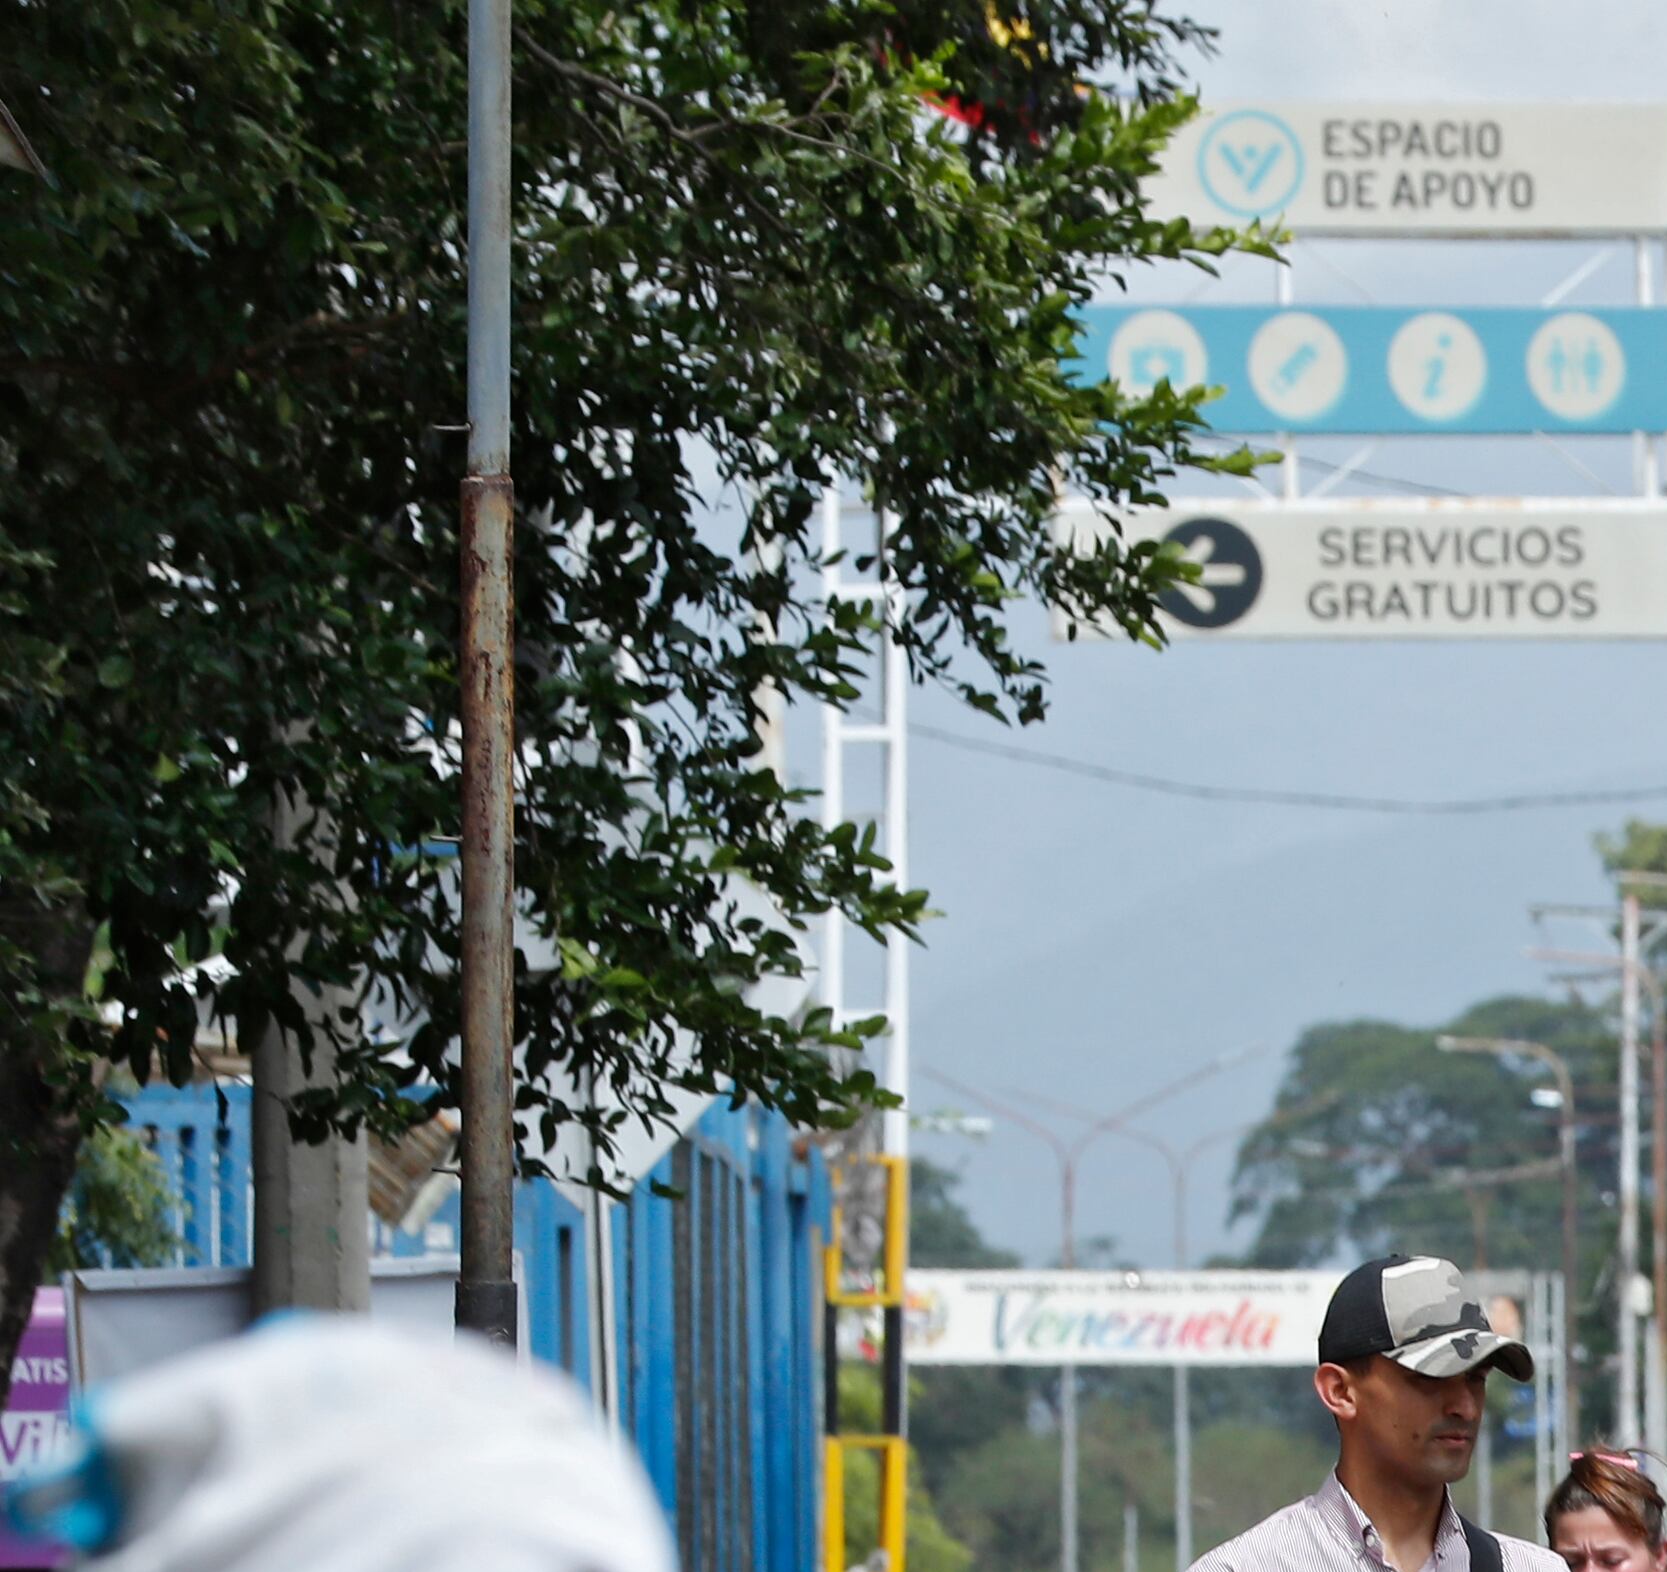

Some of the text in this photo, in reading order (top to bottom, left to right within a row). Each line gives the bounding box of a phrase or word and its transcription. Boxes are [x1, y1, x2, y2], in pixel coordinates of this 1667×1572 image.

[1320, 118, 1503, 161] ESPACIO
[1321, 168, 1536, 212] DE APOYO
[1316, 524, 1586, 570] SERVICIOS
[1304, 578, 1599, 622] GRATUITOS
[993, 1293, 1281, 1352] Venezuela
[9, 1356, 69, 1385] ATIS
